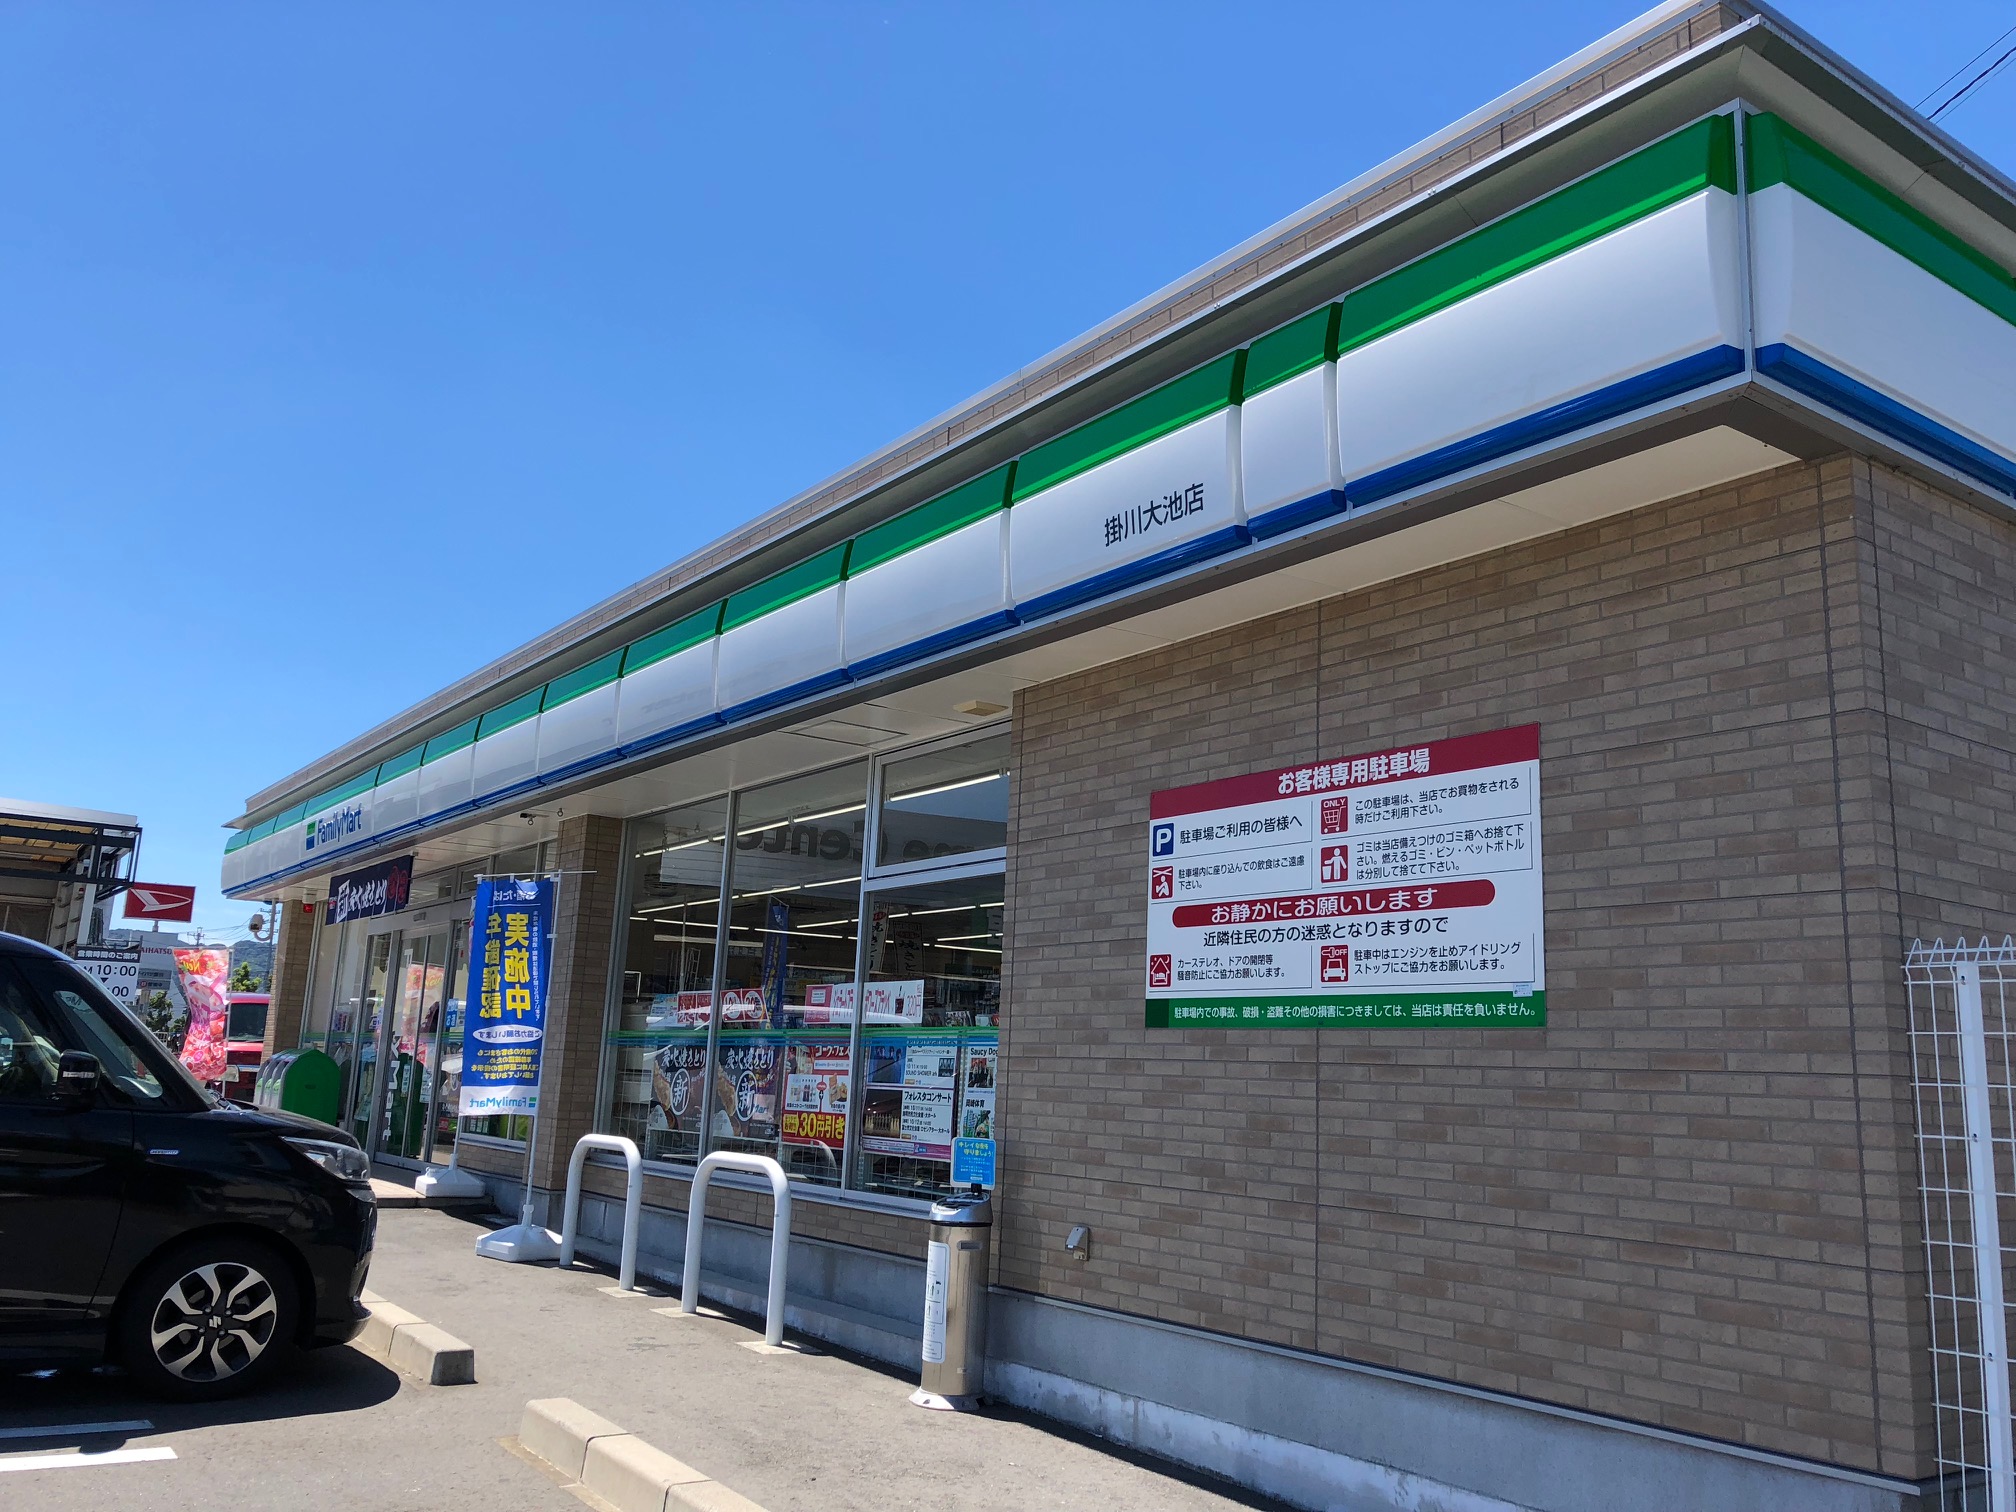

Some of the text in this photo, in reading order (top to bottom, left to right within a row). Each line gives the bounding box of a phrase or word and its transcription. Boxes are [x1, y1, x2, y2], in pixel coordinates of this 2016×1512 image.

[1104, 482, 1204, 547] 掛川大池店
[1278, 748, 1430, 796] お客様専用駐車場
[1323, 798, 1346, 809] ONLY
[1355, 777, 1519, 811] この駐車場は、当店でお買物をされる
[317, 804, 362, 845] FamilyMart
[1354, 803, 1443, 825] 時だけご利用下さい。
[1156, 828, 1172, 853] P
[1180, 815, 1303, 845] 駐車場ご利用の皆様へ
[1356, 823, 1524, 854] ゴミは当店備えつけのゴミ箱へお捨て下
[1178, 854, 1305, 879] 駐車場内に座り込んでの飲食はご遠慮
[1356, 860, 1460, 880] は分別して捨てて下さい。
[1178, 880, 1203, 891] 下さい。
[1211, 887, 1438, 923] お静かにお願いします
[1203, 916, 1449, 947] 近隣住民の方の迷惑となりますので
[1177, 954, 1273, 968] カーステレオ、ドアの開閉等
[1335, 948, 1348, 956] OFF
[1353, 941, 1522, 961] 駐車中はエンジンを止めアイドリング
[96, 964, 137, 977] 10:00
[1177, 966, 1285, 981] 騒音防止にご協力お願いします。
[1354, 958, 1506, 975] ストップにご協力をお願いします。
[970, 1048, 987, 1057] Saucy
[672, 1074, 688, 1109] 新
[738, 1077, 756, 1115] 新
[904, 1090, 952, 1104] フォレスタコンサート
